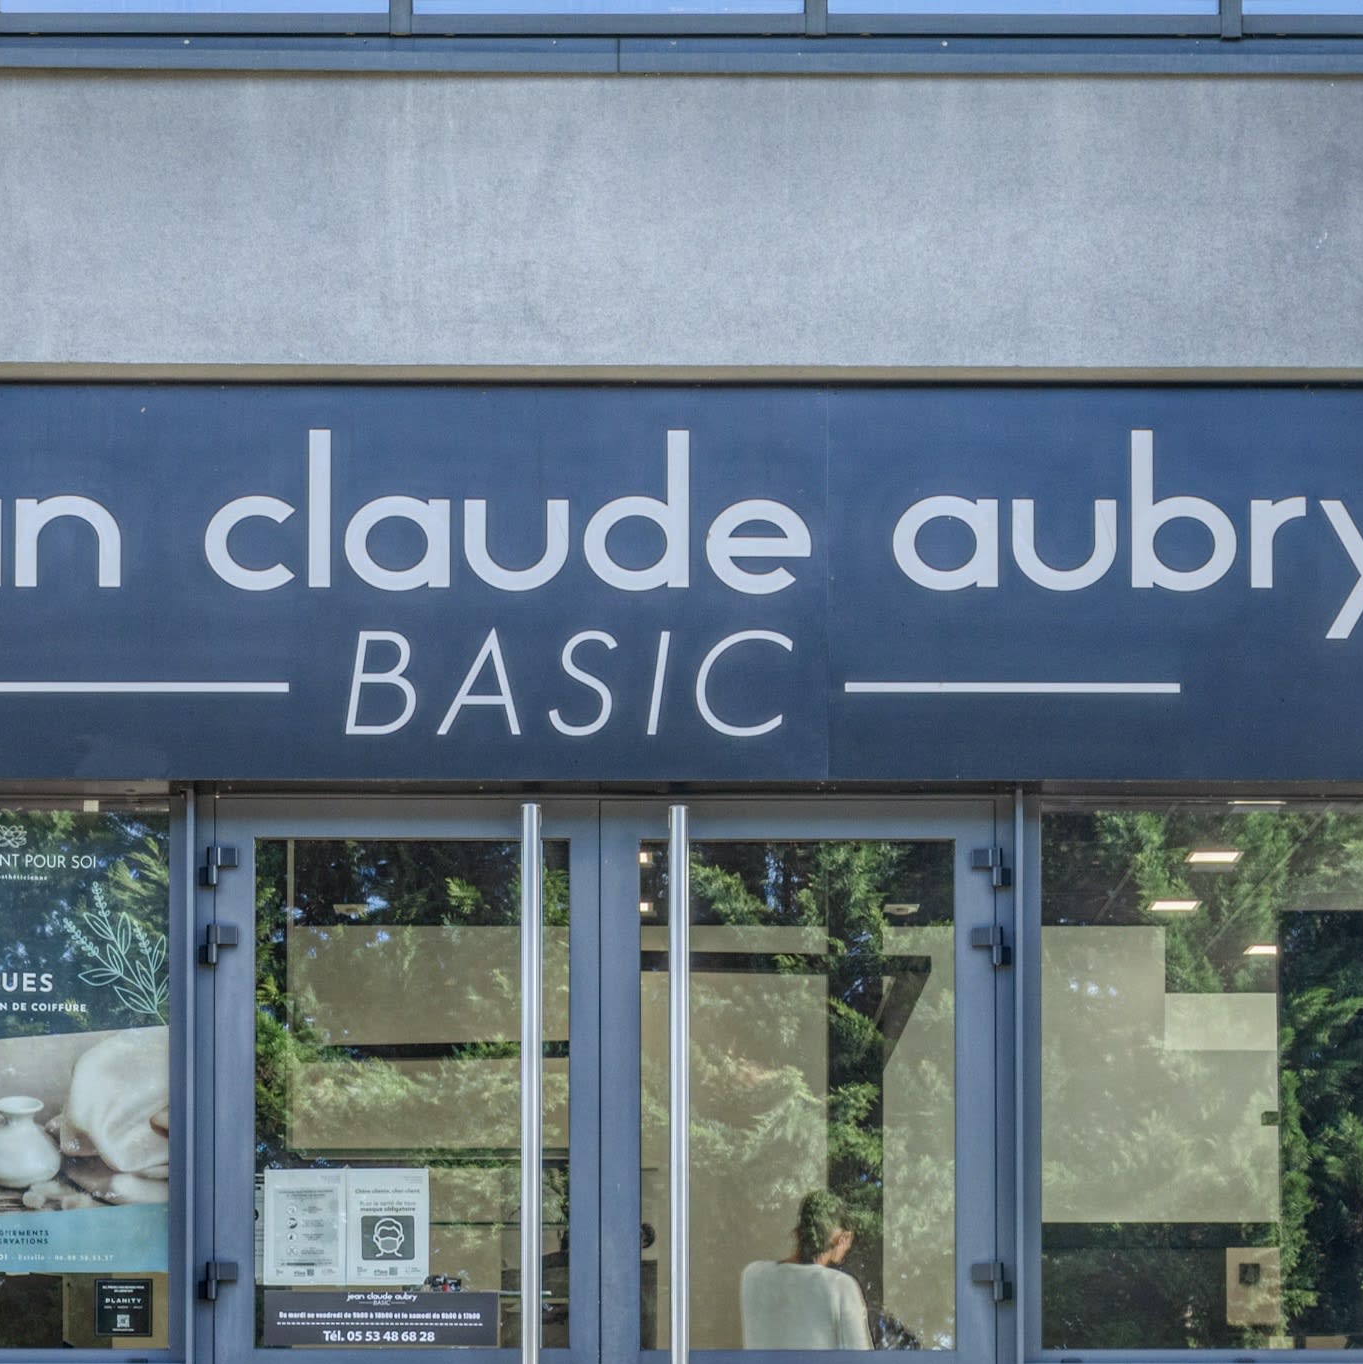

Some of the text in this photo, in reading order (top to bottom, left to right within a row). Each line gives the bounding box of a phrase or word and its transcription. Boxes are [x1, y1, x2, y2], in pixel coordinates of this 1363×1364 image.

[205, 428, 813, 595] claude
[345, 629, 793, 737] BASIC
[24, 854, 66, 868] POUR
[71, 855, 97, 869] SOI
[12, 1001, 27, 1011] DE
[31, 1002, 87, 1013] COIFFURE
[346, 1291, 418, 1302] jean claude aubry
[323, 1330, 435, 1342] Tél. 05 53 48 68 28
